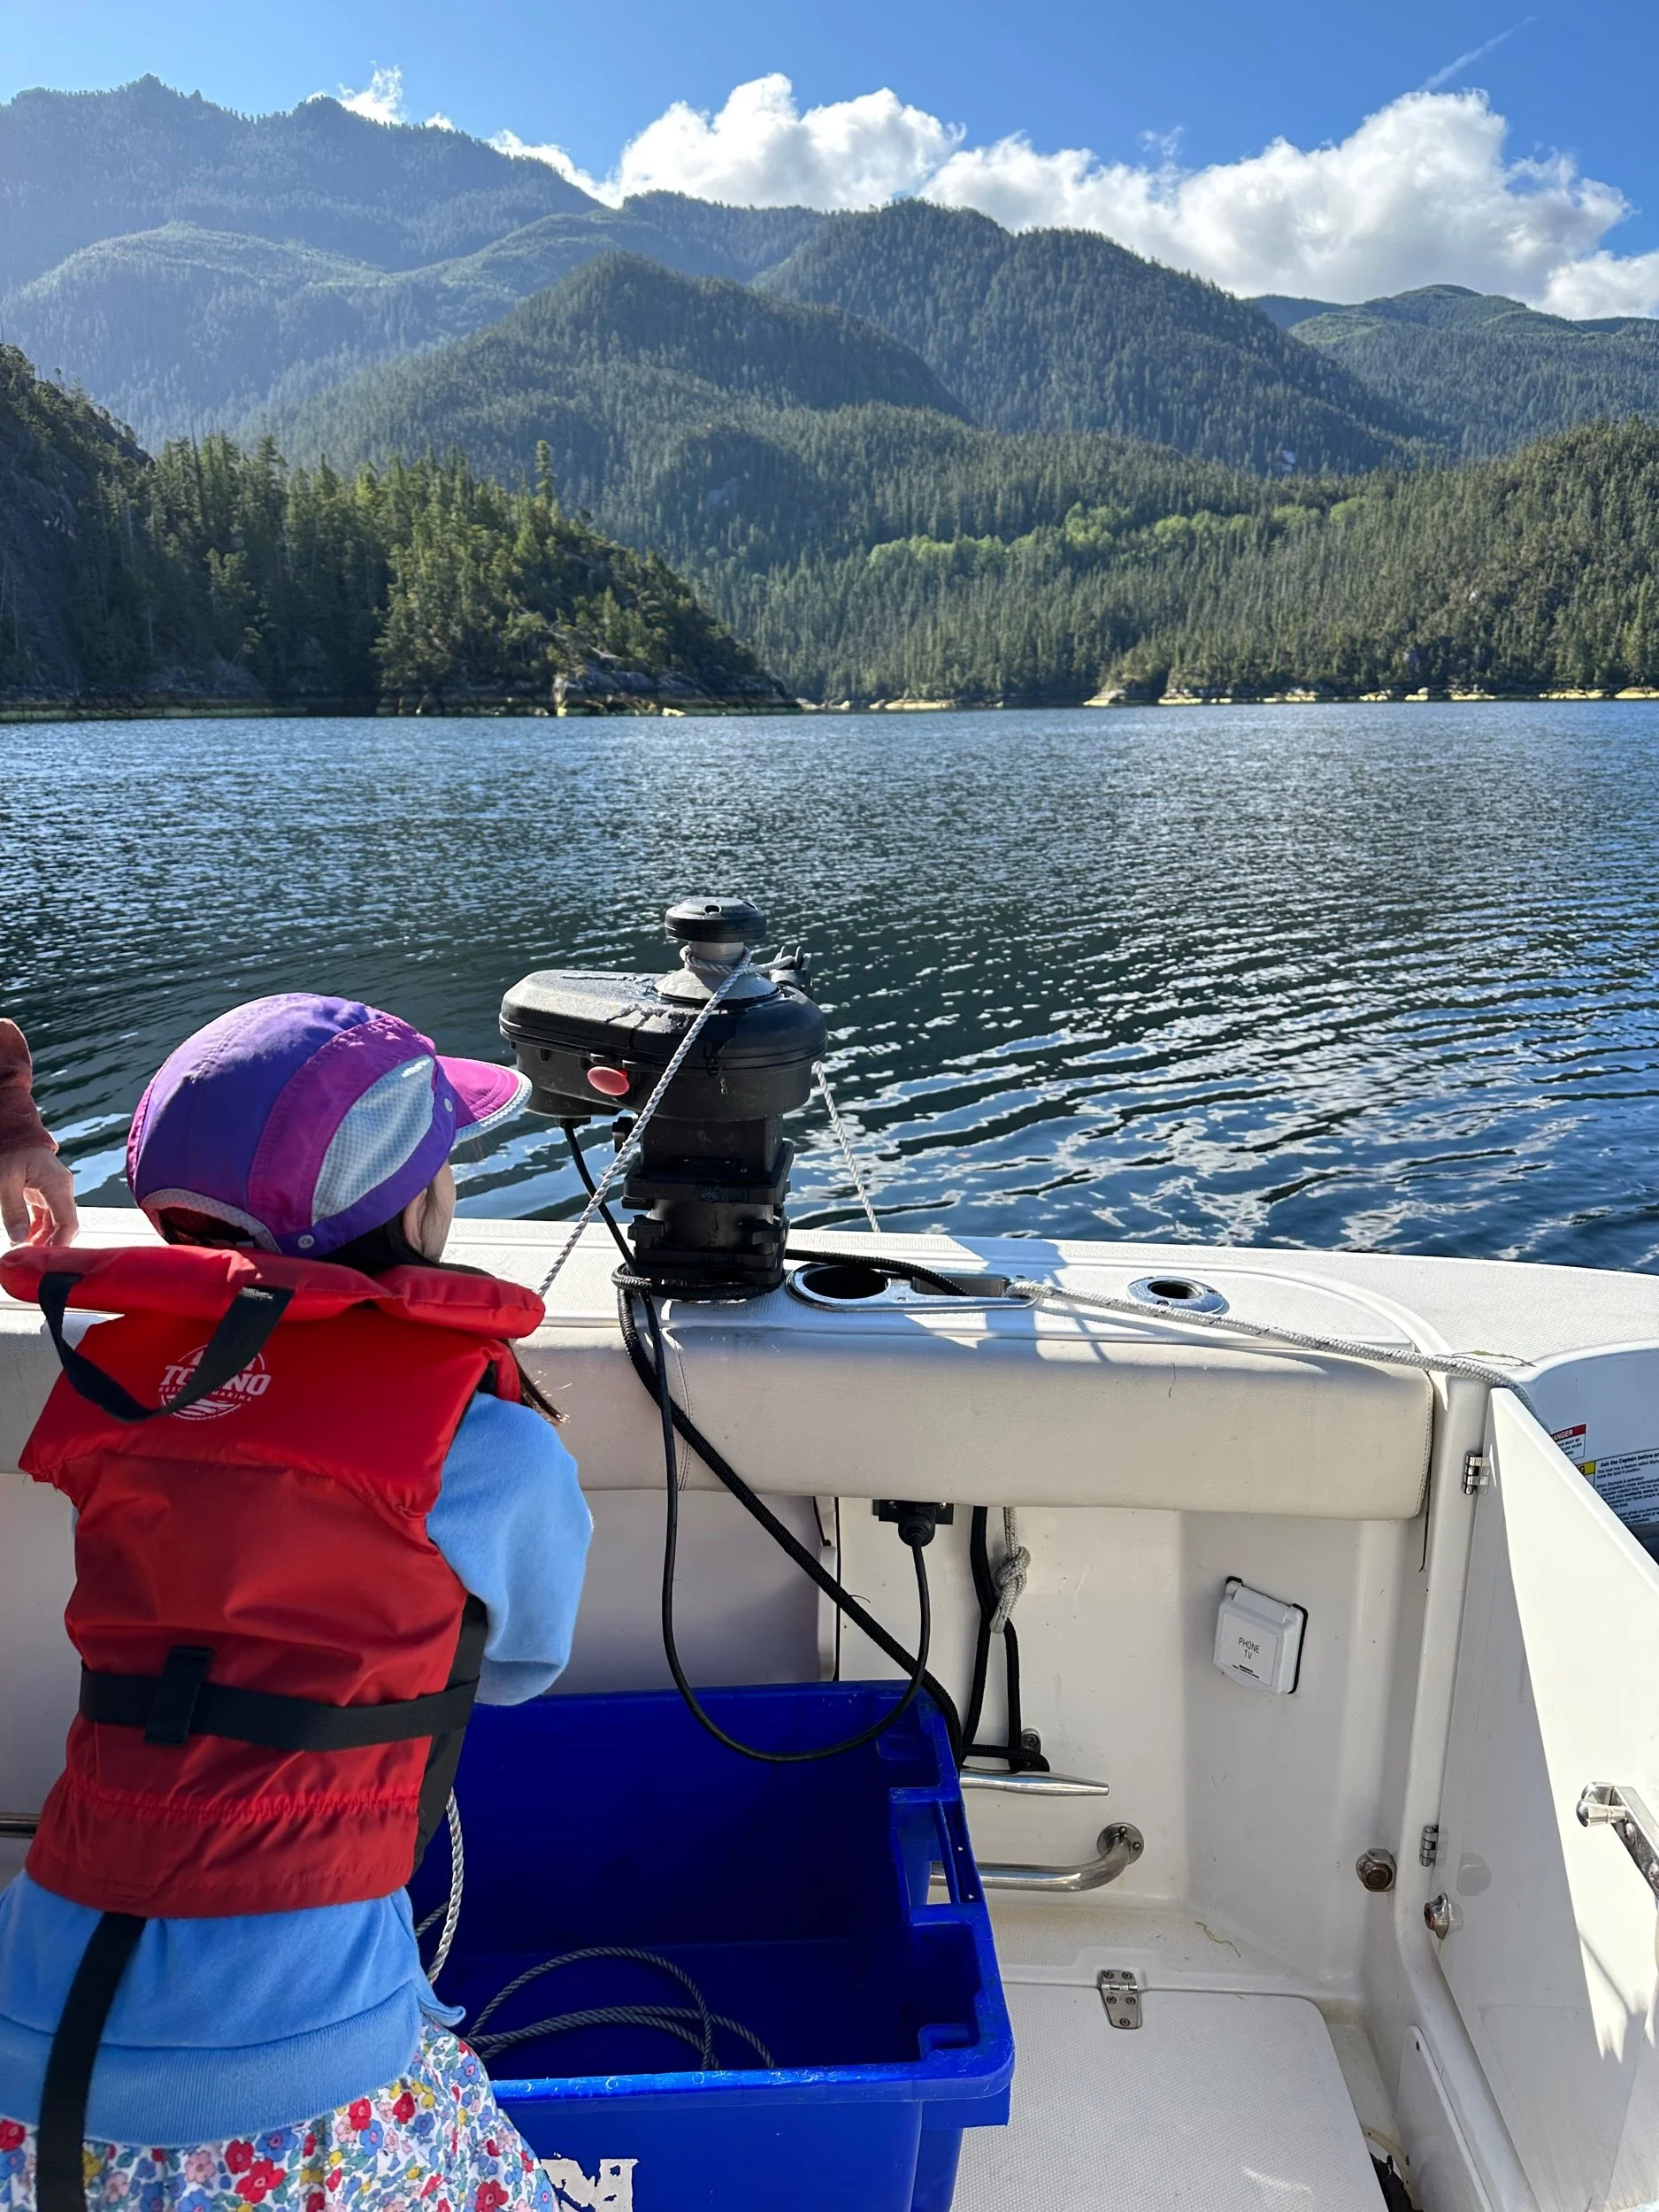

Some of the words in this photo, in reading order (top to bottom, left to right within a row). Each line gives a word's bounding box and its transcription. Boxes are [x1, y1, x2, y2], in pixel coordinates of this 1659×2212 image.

[211, 1390, 251, 1402] MARINA
[1239, 1636, 1260, 1654] PHONE
[1244, 1649, 1253, 1660] TV
